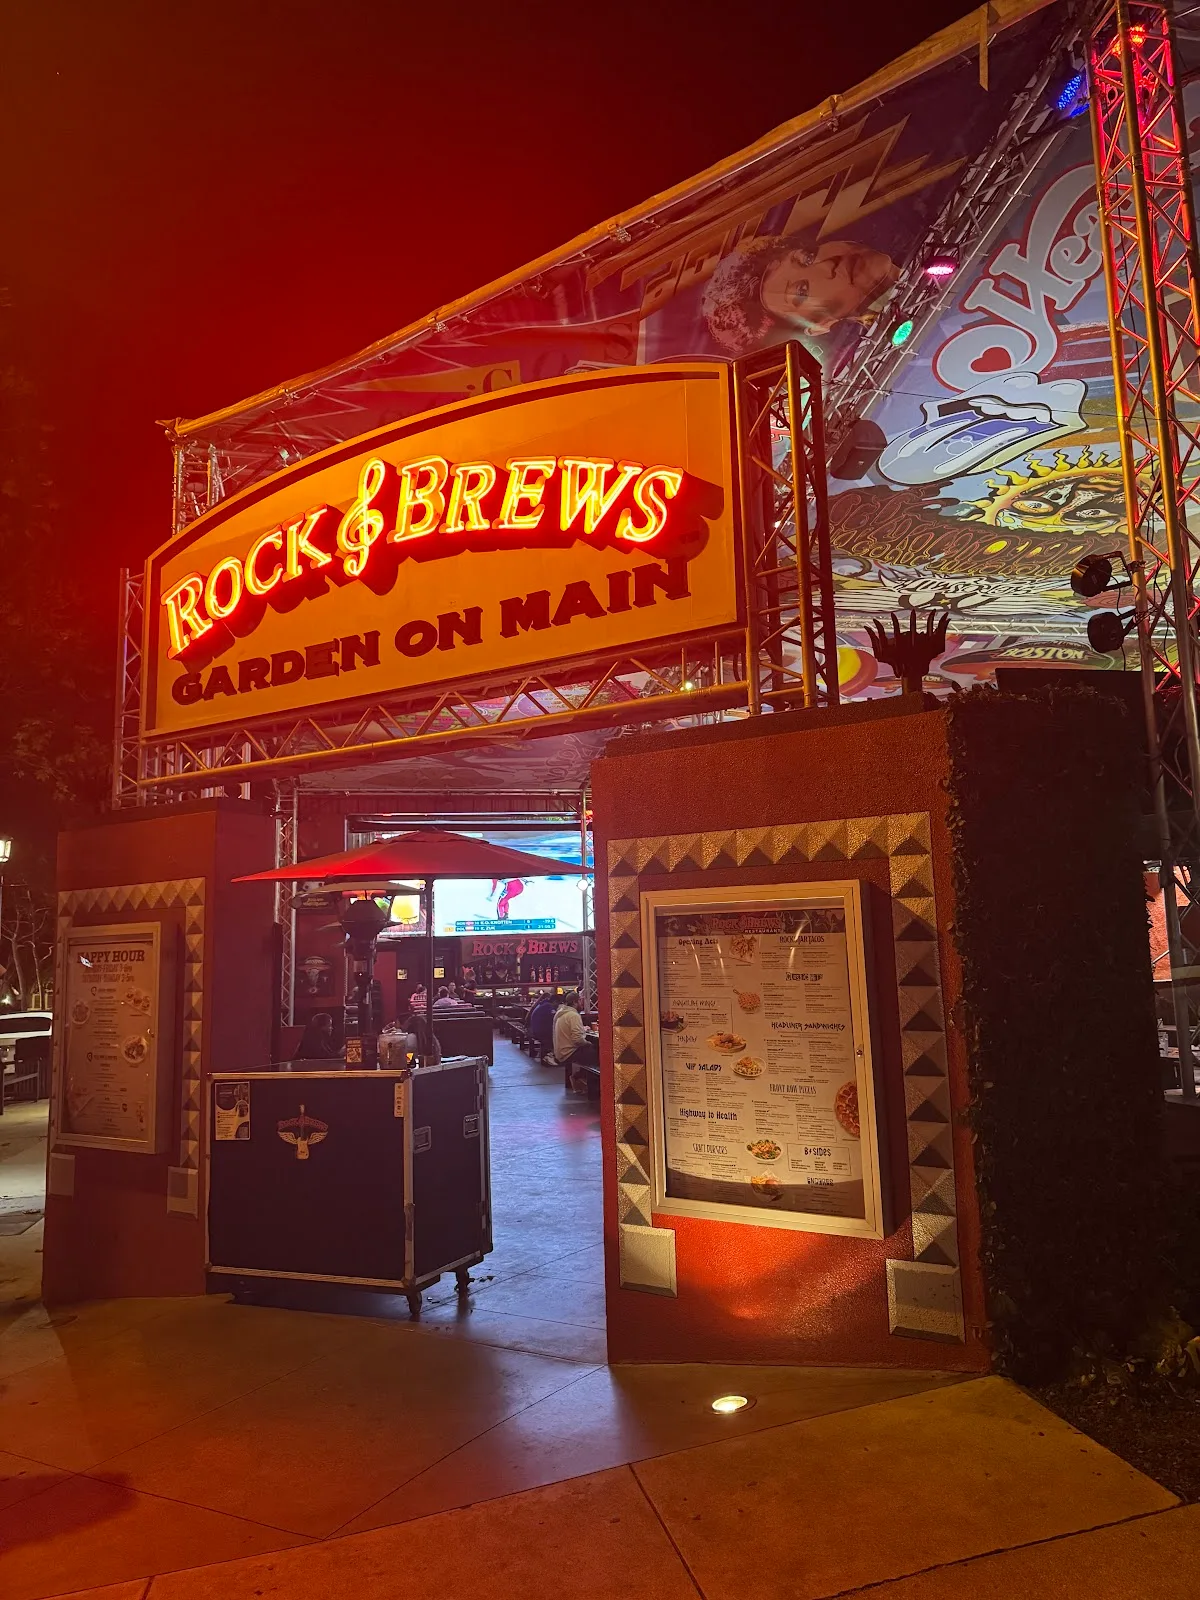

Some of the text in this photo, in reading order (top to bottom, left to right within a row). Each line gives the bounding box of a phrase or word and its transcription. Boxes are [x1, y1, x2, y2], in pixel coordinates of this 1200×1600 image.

[161, 504, 333, 659] ROCK
[390, 454, 686, 544] BREWS
[171, 558, 692, 706] GARDEN ON MAIN
[996, 646, 1086, 661] BOSTON
[712, 917, 739, 930] ROCK
[472, 940, 514, 956] ROCK
[526, 938, 578, 955] BREWS
[76, 949, 145, 964] HAPPY HOUR
[685, 1062, 722, 1072] VIP SALADS
[679, 1107, 738, 1121] Highway to Health
